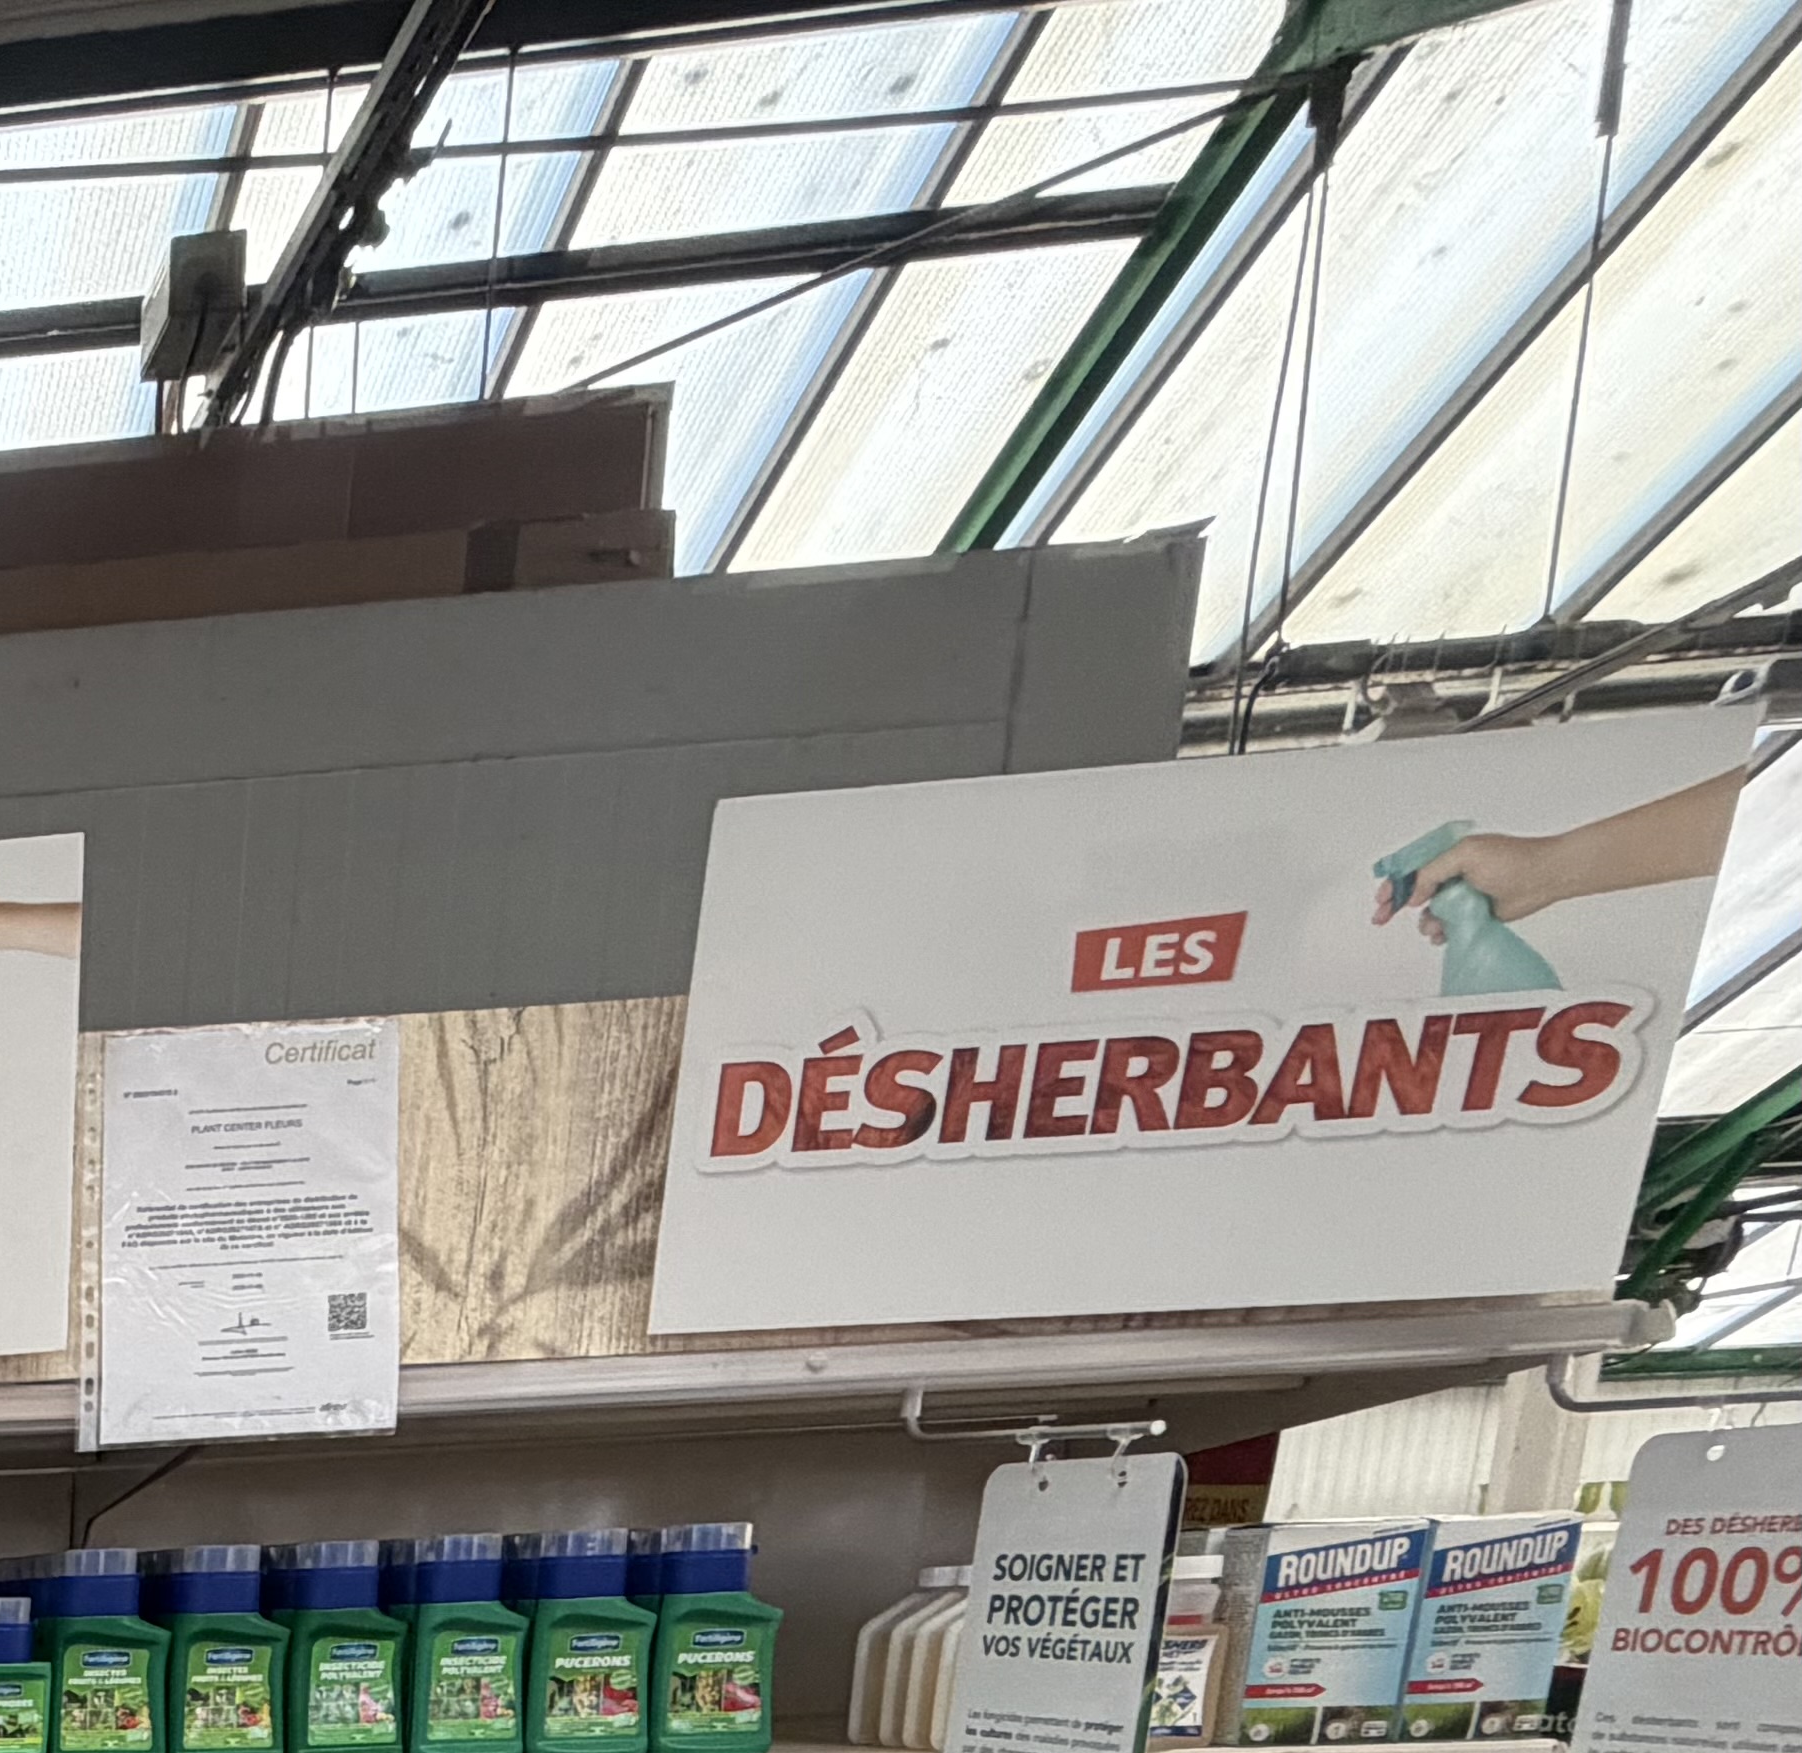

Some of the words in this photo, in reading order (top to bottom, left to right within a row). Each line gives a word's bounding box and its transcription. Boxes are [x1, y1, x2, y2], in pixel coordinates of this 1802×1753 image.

[1098, 930, 1216, 983] LES
[265, 1039, 376, 1065] Certificat
[709, 1002, 1632, 1158] DÉSHERBANTS
[191, 1123, 222, 1134] PLANT
[224, 1121, 262, 1133] CENTER
[265, 1120, 303, 1131] FLEURIS
[1666, 1518, 1705, 1536] DES
[993, 1553, 1106, 1582] SOIGNER
[1114, 1554, 1146, 1582] ET
[1277, 1537, 1411, 1588] ROUNDUP
[1442, 1530, 1569, 1583] ROUNDUP
[987, 1588, 1140, 1629] PROTÉGER
[1271, 1618, 1357, 1629] POLYVALENT
[555, 1655, 632, 1668] PUCERONS
[678, 1651, 755, 1665] PUCERONS
[982, 1634, 1021, 1657] VOS
[1028, 1632, 1134, 1664] VÉGÉTAUX
